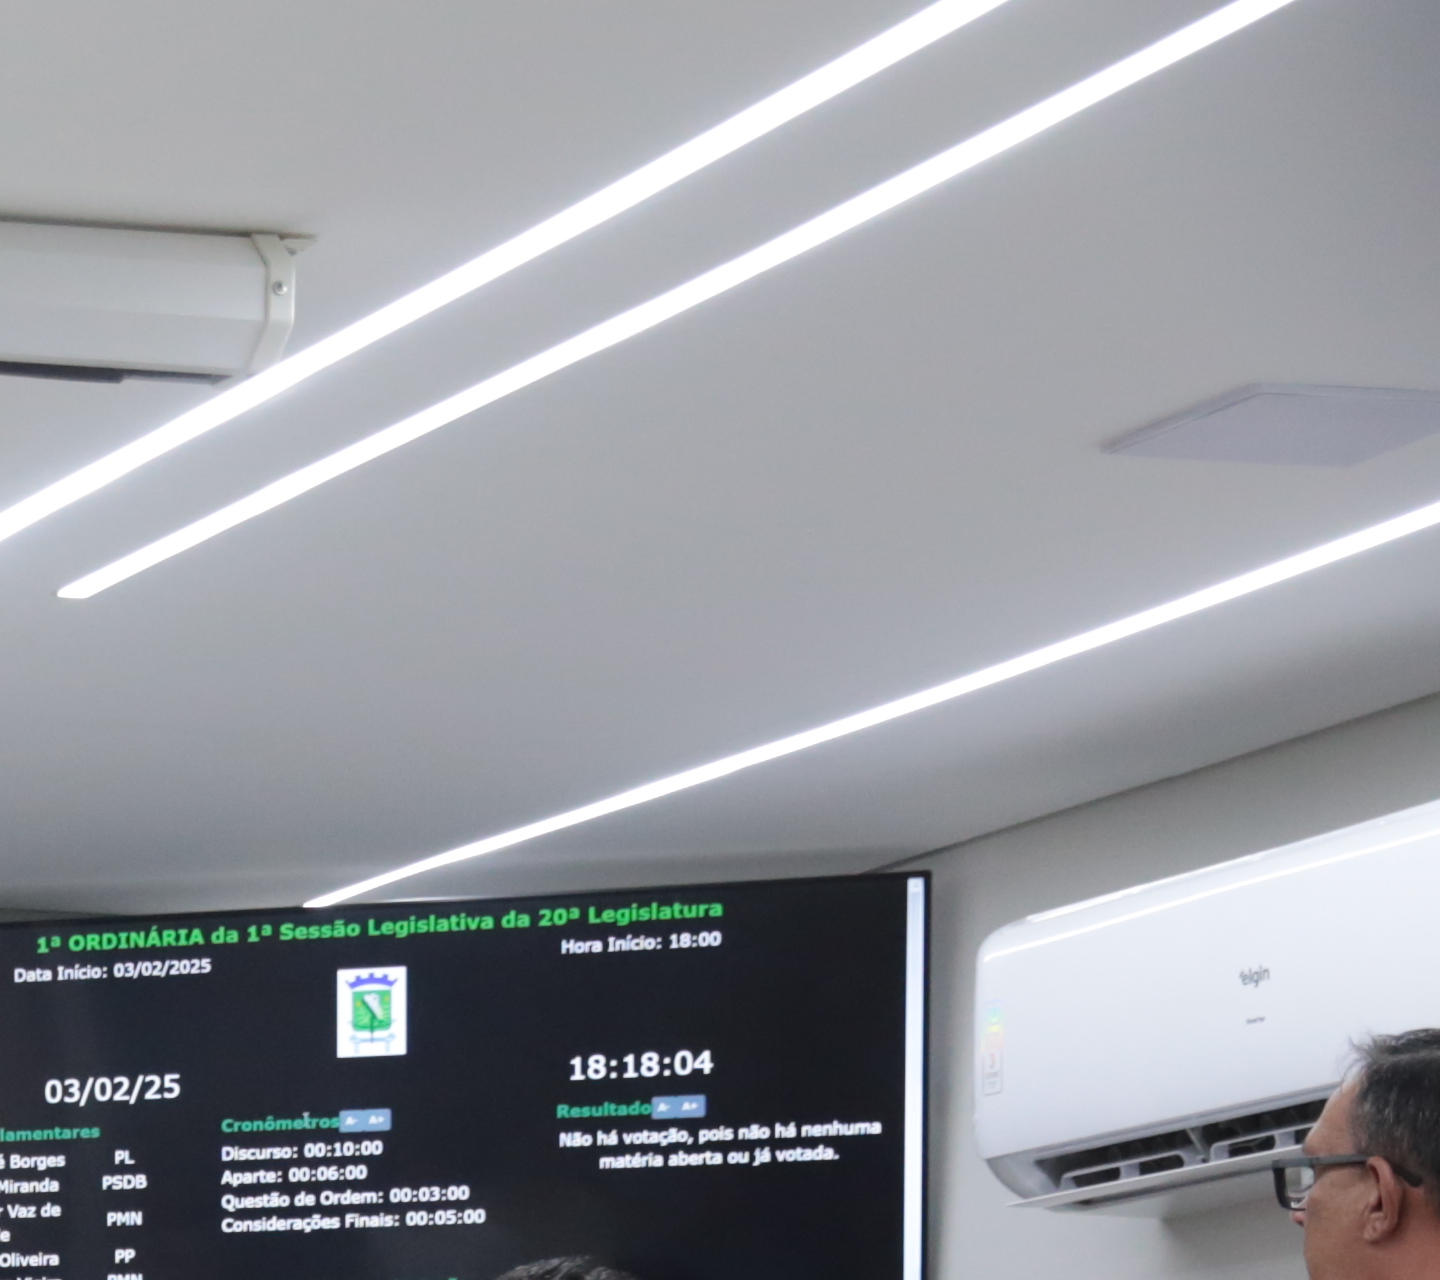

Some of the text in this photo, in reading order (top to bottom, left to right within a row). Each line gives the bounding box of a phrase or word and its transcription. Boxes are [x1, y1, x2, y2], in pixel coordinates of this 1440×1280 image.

[69, 926, 204, 951] ORDINÁRIA
[211, 926, 239, 944] da
[280, 920, 361, 940] Sessão
[368, 913, 494, 938] Legislativa
[501, 910, 530, 928] da
[539, 907, 580, 926] 20ª
[588, 902, 723, 926] Legislatura
[561, 931, 722, 954] Hora Início: 18:00
[14, 958, 211, 983] Data Início: 03/02/2025
[570, 1050, 714, 1080] 18:18:04
[45, 1074, 180, 1106] 03/02/25
[557, 1102, 652, 1118] Resultado
[221, 1117, 340, 1132] Cronômetros
[559, 1120, 882, 1147] Não há votação, pois não há nenhuma
[115, 1150, 135, 1164] PL
[221, 1140, 383, 1161] Discurso: 00:10:00
[599, 1145, 839, 1169] matéria aberta ou já votada.
[10, 1154, 66, 1170] Borges
[102, 1174, 147, 1190] PSDB
[221, 1165, 367, 1187] Aparte: 00:06:00
[221, 1185, 470, 1212] Questão de Ordem: 00:03:00
[7, 1204, 36, 1218] Vaz
[40, 1202, 61, 1217] de
[107, 1211, 142, 1226] PMN
[221, 1209, 486, 1233] Considerações Finais: 00:05:00
[115, 1249, 135, 1263] PP
